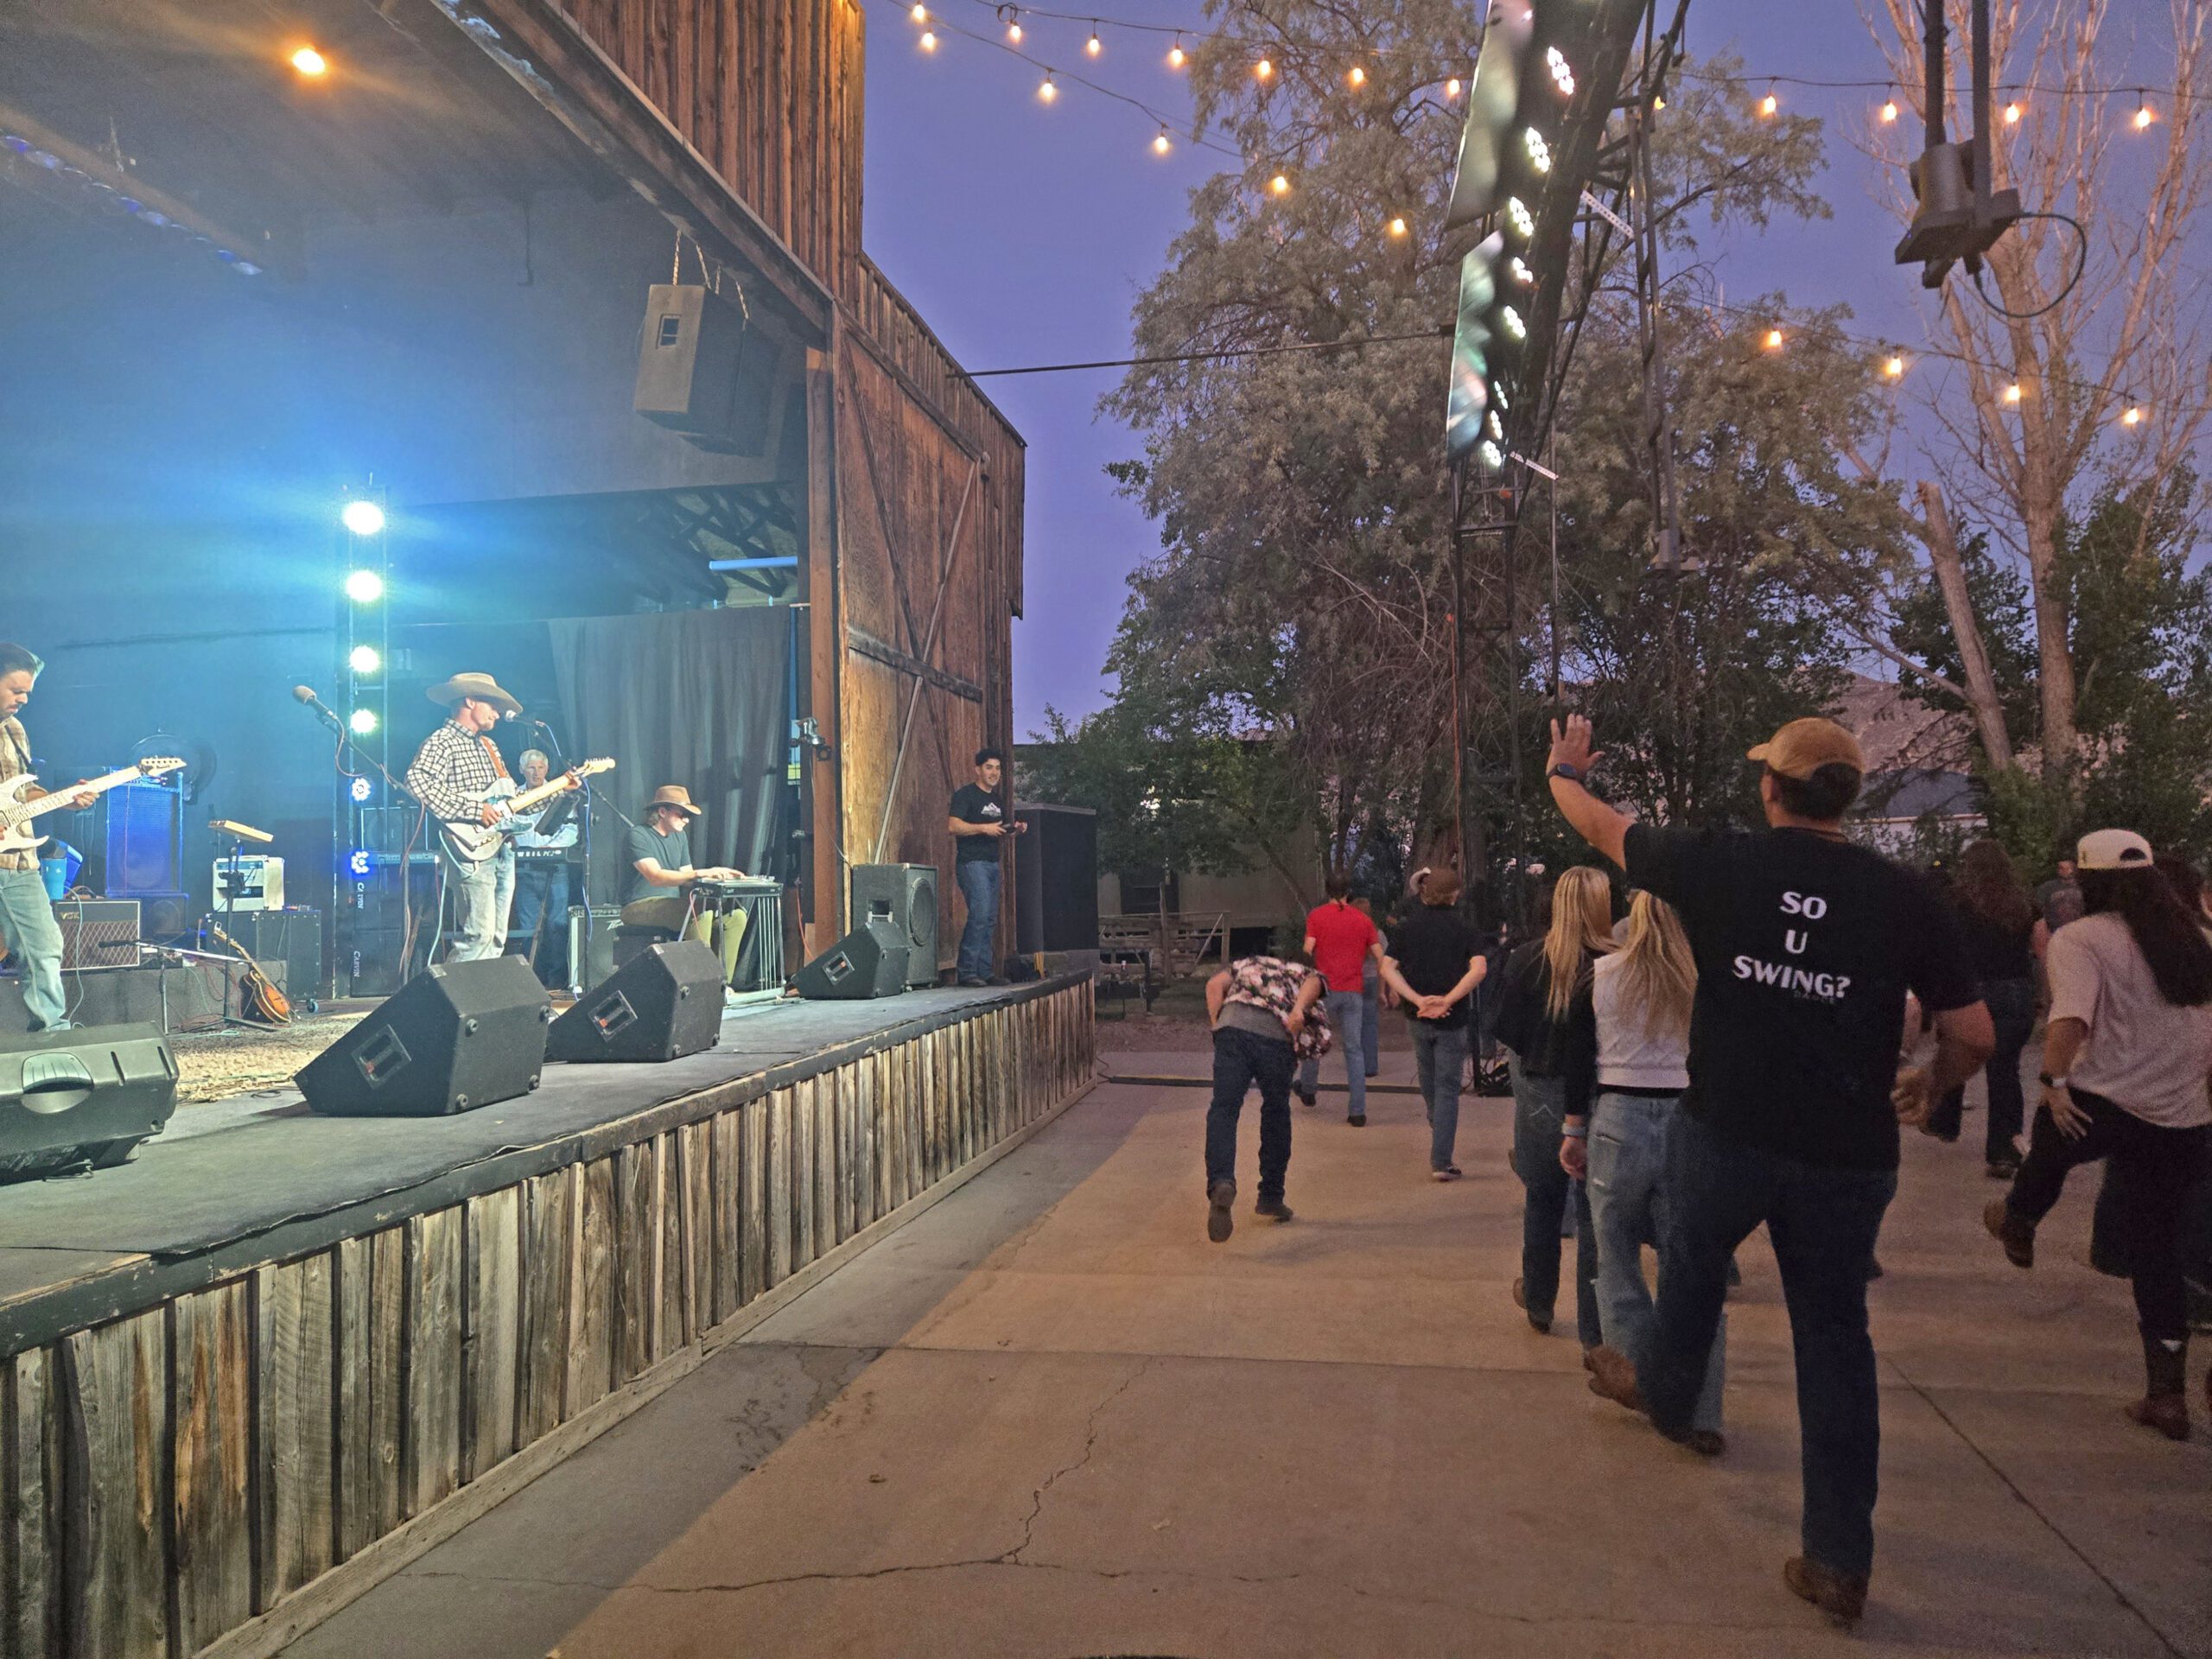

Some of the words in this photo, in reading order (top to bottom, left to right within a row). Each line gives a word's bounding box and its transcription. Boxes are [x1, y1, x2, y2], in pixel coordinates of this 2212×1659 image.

[1779, 891, 1827, 919] SO
[1784, 929, 1808, 954] U
[1732, 955, 1852, 998] SWING?
